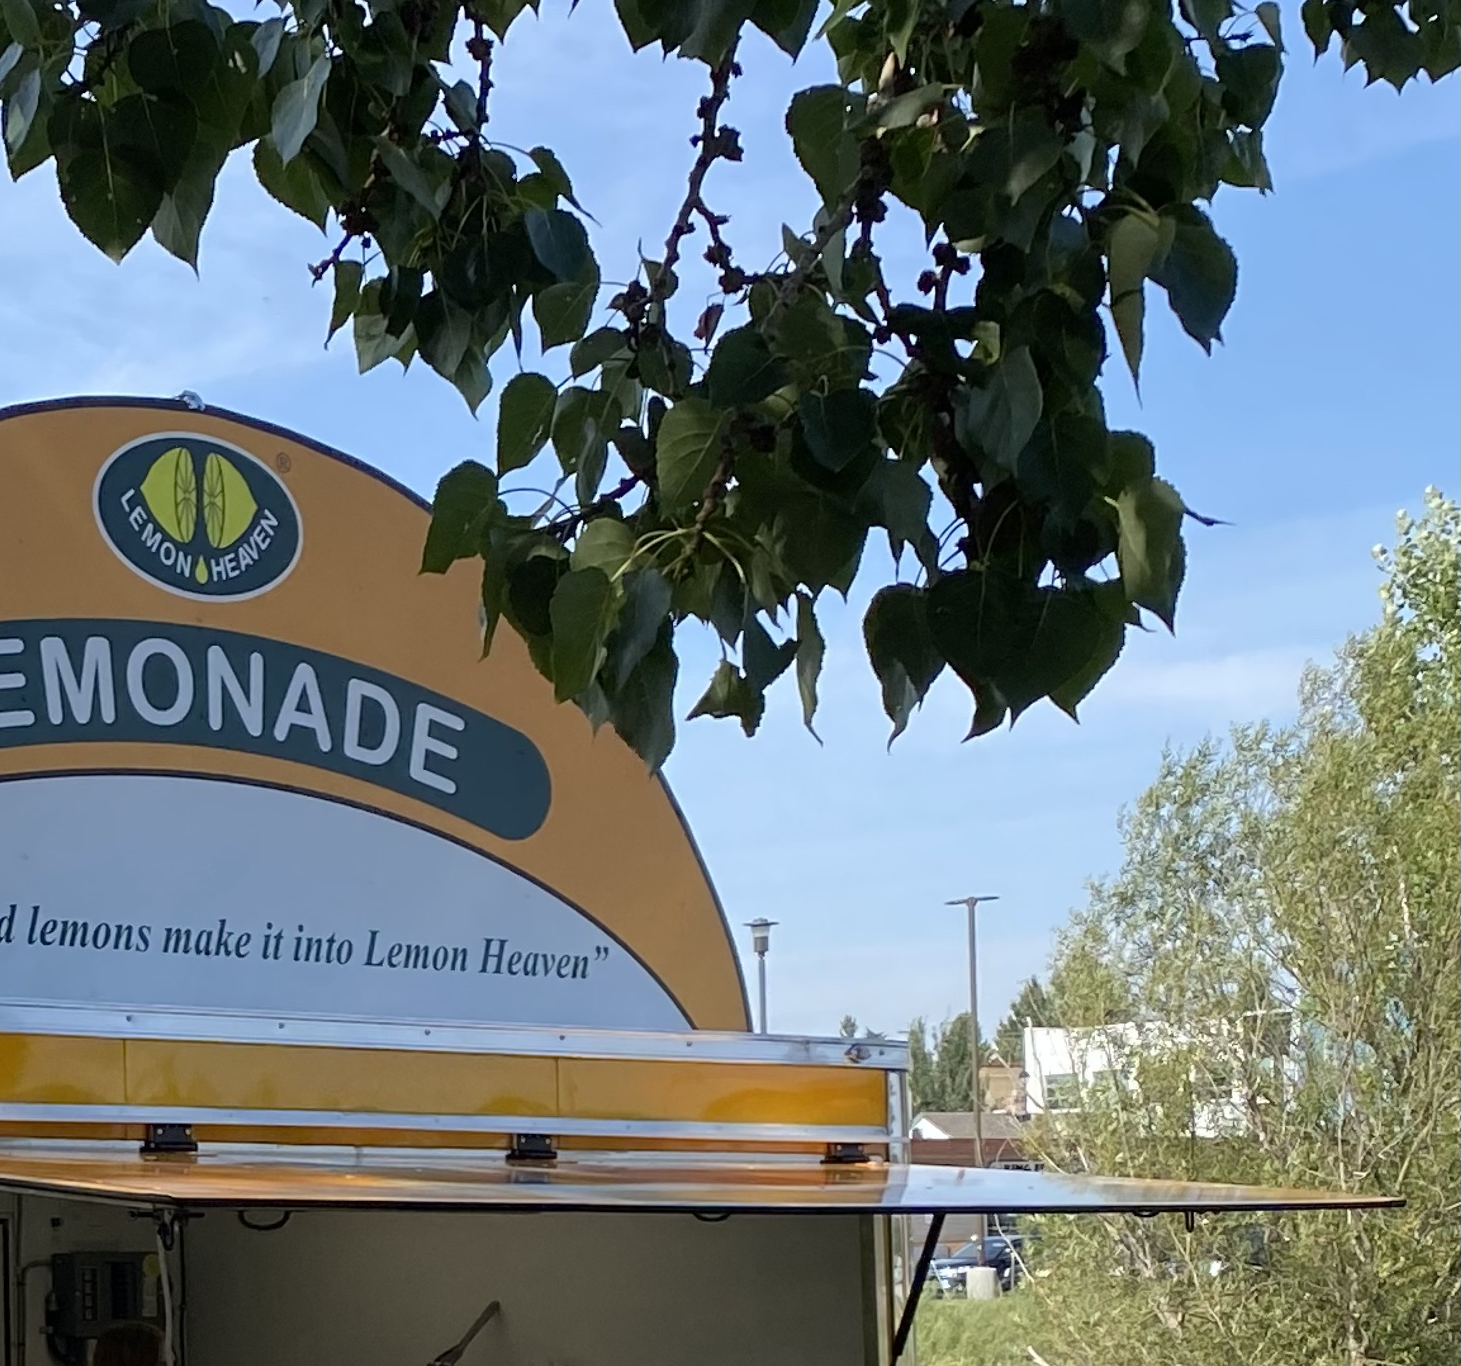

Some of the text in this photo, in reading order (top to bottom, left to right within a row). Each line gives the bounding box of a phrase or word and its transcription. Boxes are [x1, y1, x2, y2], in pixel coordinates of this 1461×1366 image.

[120, 488, 279, 582] LEMON HEAVEN
[27, 905, 151, 954] lemons
[162, 918, 253, 959] make
[261, 921, 285, 961] it
[292, 923, 354, 966] into
[362, 929, 470, 973] Lemon
[478, 937, 610, 980] Heaven”
